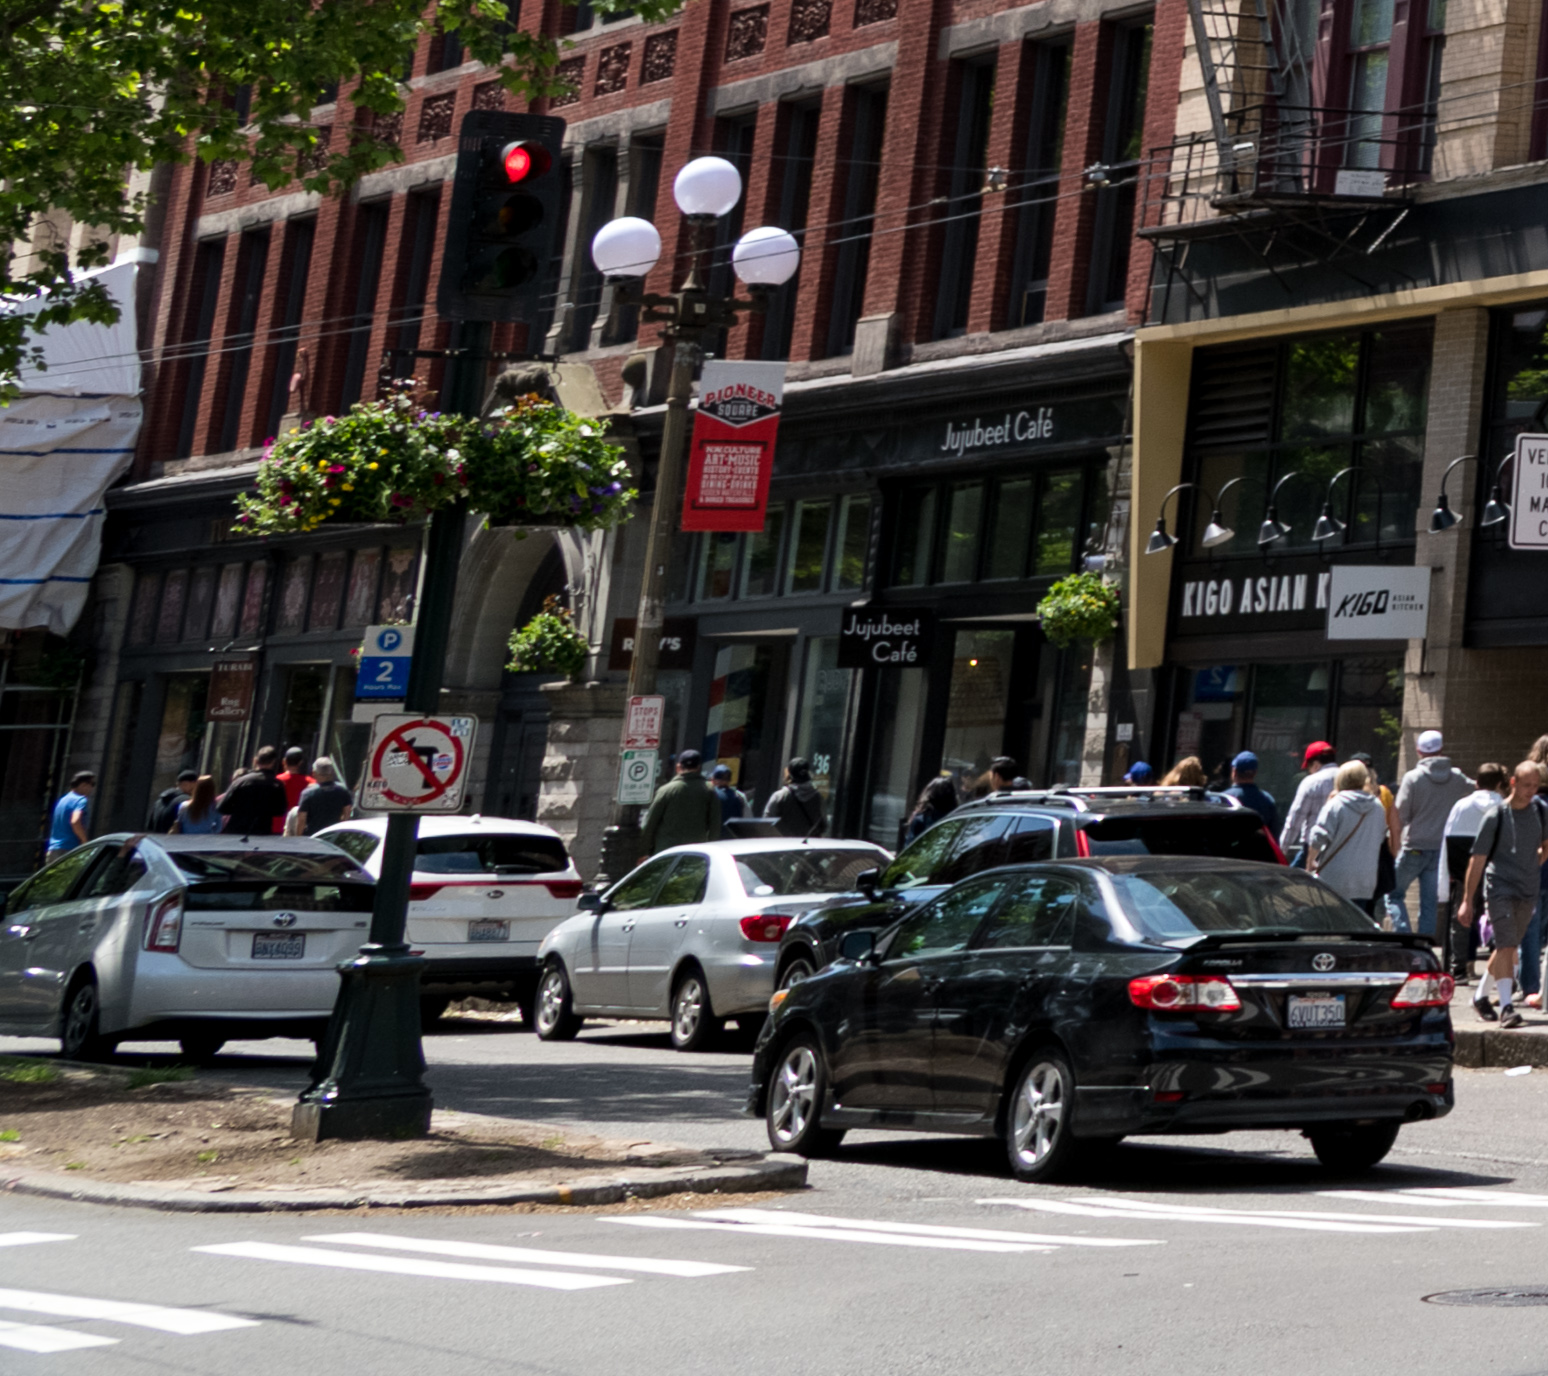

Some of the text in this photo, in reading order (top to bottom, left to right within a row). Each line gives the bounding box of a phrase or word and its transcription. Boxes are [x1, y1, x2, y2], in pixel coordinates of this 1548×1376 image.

[703, 383, 776, 409] PIONEER
[717, 404, 759, 417] SQUARE
[941, 407, 1053, 457] Jujubeet Café
[1182, 579, 1233, 617] KIGO
[1239, 574, 1308, 614] ASIAN
[1392, 594, 1416, 602] ASIAN
[843, 614, 921, 640] Jujubeet
[872, 641, 918, 662] Café
[376, 661, 395, 682] 2
[210, 706, 247, 716] Gallery
[220, 697, 241, 708] Rug
[813, 752, 830, 775] $36
